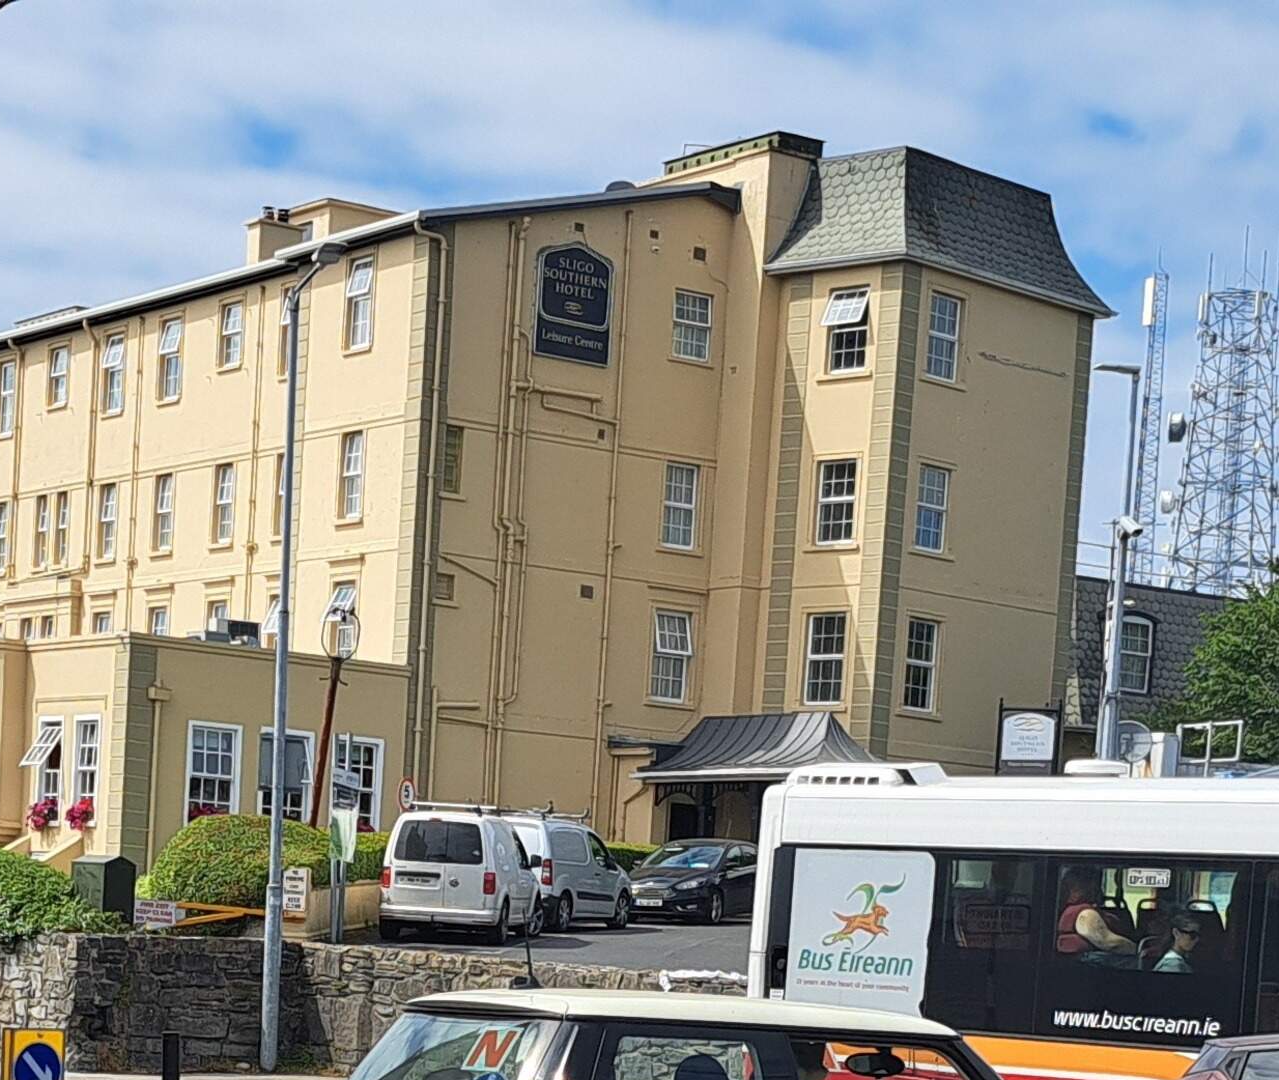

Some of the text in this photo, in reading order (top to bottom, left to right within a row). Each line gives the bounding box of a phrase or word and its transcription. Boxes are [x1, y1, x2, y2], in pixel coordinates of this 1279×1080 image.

[559, 257, 594, 273] SLIGO
[543, 267, 607, 289] SOUTHERN
[555, 282, 594, 299] HOTEL
[574, 335, 603, 350] Centre
[403, 785, 410, 799] 5
[798, 949, 834, 970] Bus
[466, 1029, 517, 1068] N
